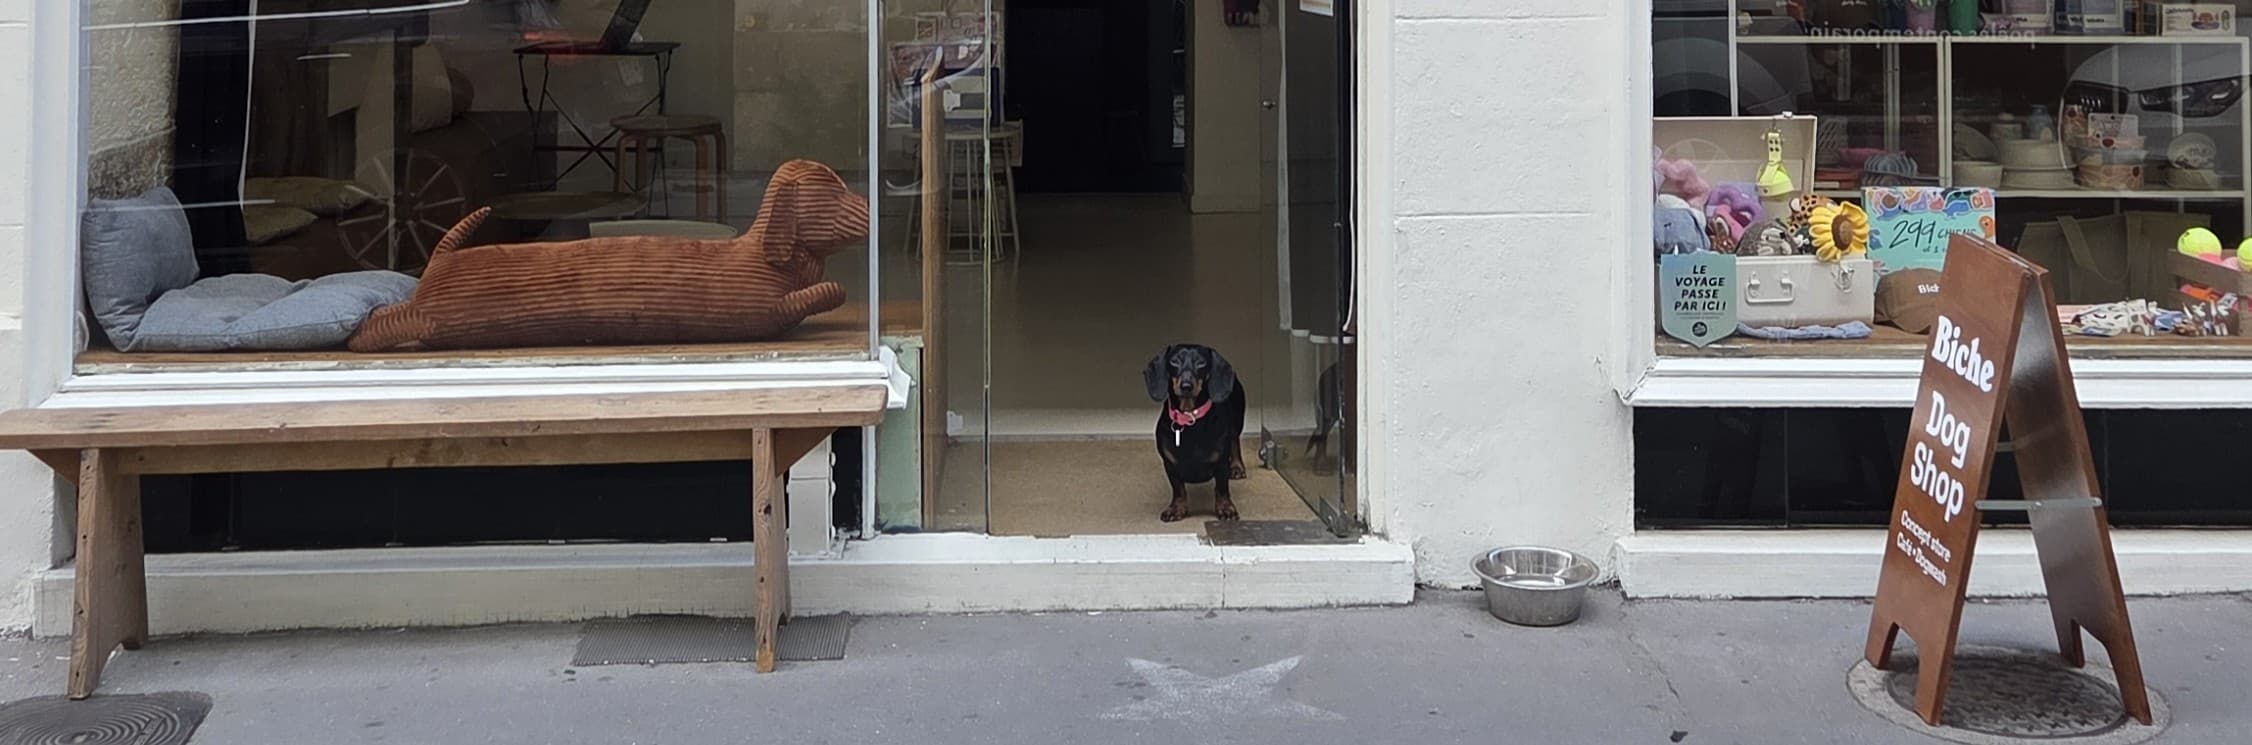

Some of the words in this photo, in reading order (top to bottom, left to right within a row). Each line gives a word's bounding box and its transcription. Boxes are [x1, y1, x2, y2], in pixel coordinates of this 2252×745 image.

[1889, 218, 1936, 248] 299
[1675, 277, 1725, 287] VOYAGE
[1693, 265, 1707, 274] LE
[1674, 301, 1698, 311] PAR
[1681, 289, 1719, 299] PASSE
[1931, 315, 1995, 392] Biche
[1925, 390, 1971, 469] Dog
[1910, 441, 1964, 523] Shop
[1897, 531, 1913, 556] Café
[1901, 510, 1931, 546] Concept
[1930, 538, 1951, 563] store
